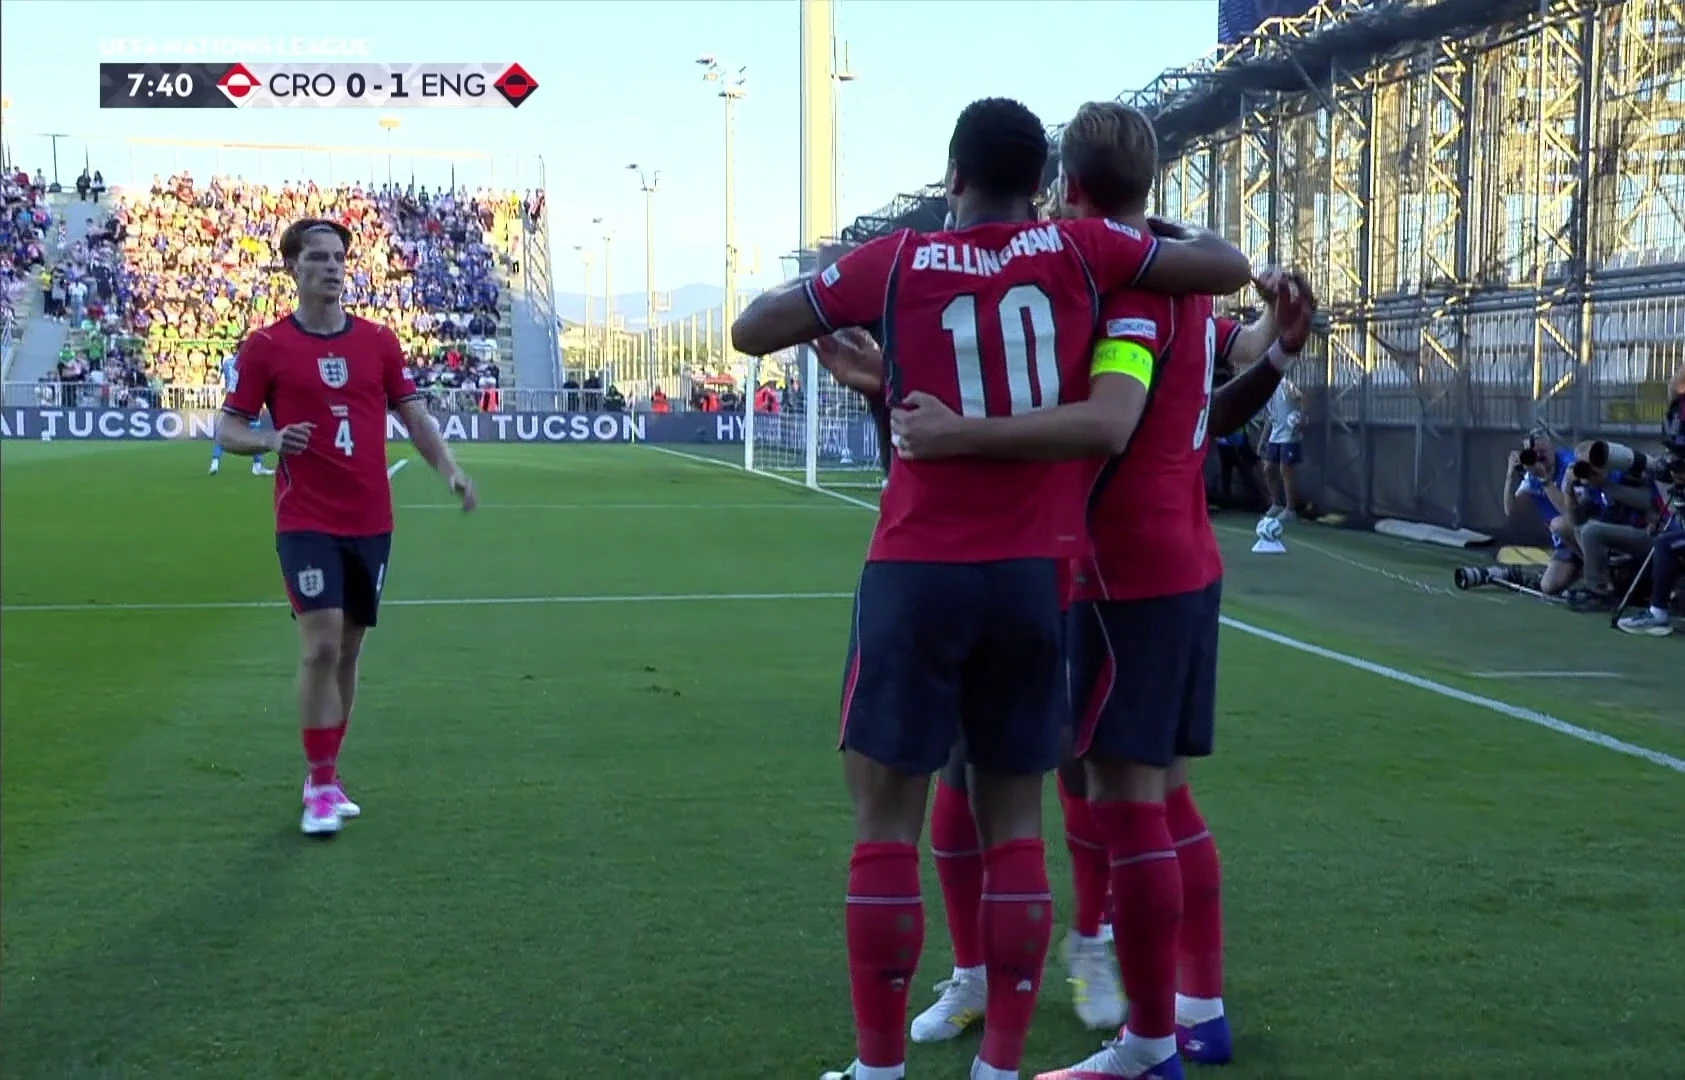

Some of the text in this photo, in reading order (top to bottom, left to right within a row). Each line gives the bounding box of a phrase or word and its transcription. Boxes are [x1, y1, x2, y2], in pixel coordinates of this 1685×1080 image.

[911, 223, 1064, 277] BELLINGHAM
[941, 284, 1061, 418] 10
[40, 410, 215, 438] TUCSON
[386, 414, 479, 440] NAI
[492, 415, 646, 440] TUCSON
[335, 418, 354, 457] 4
